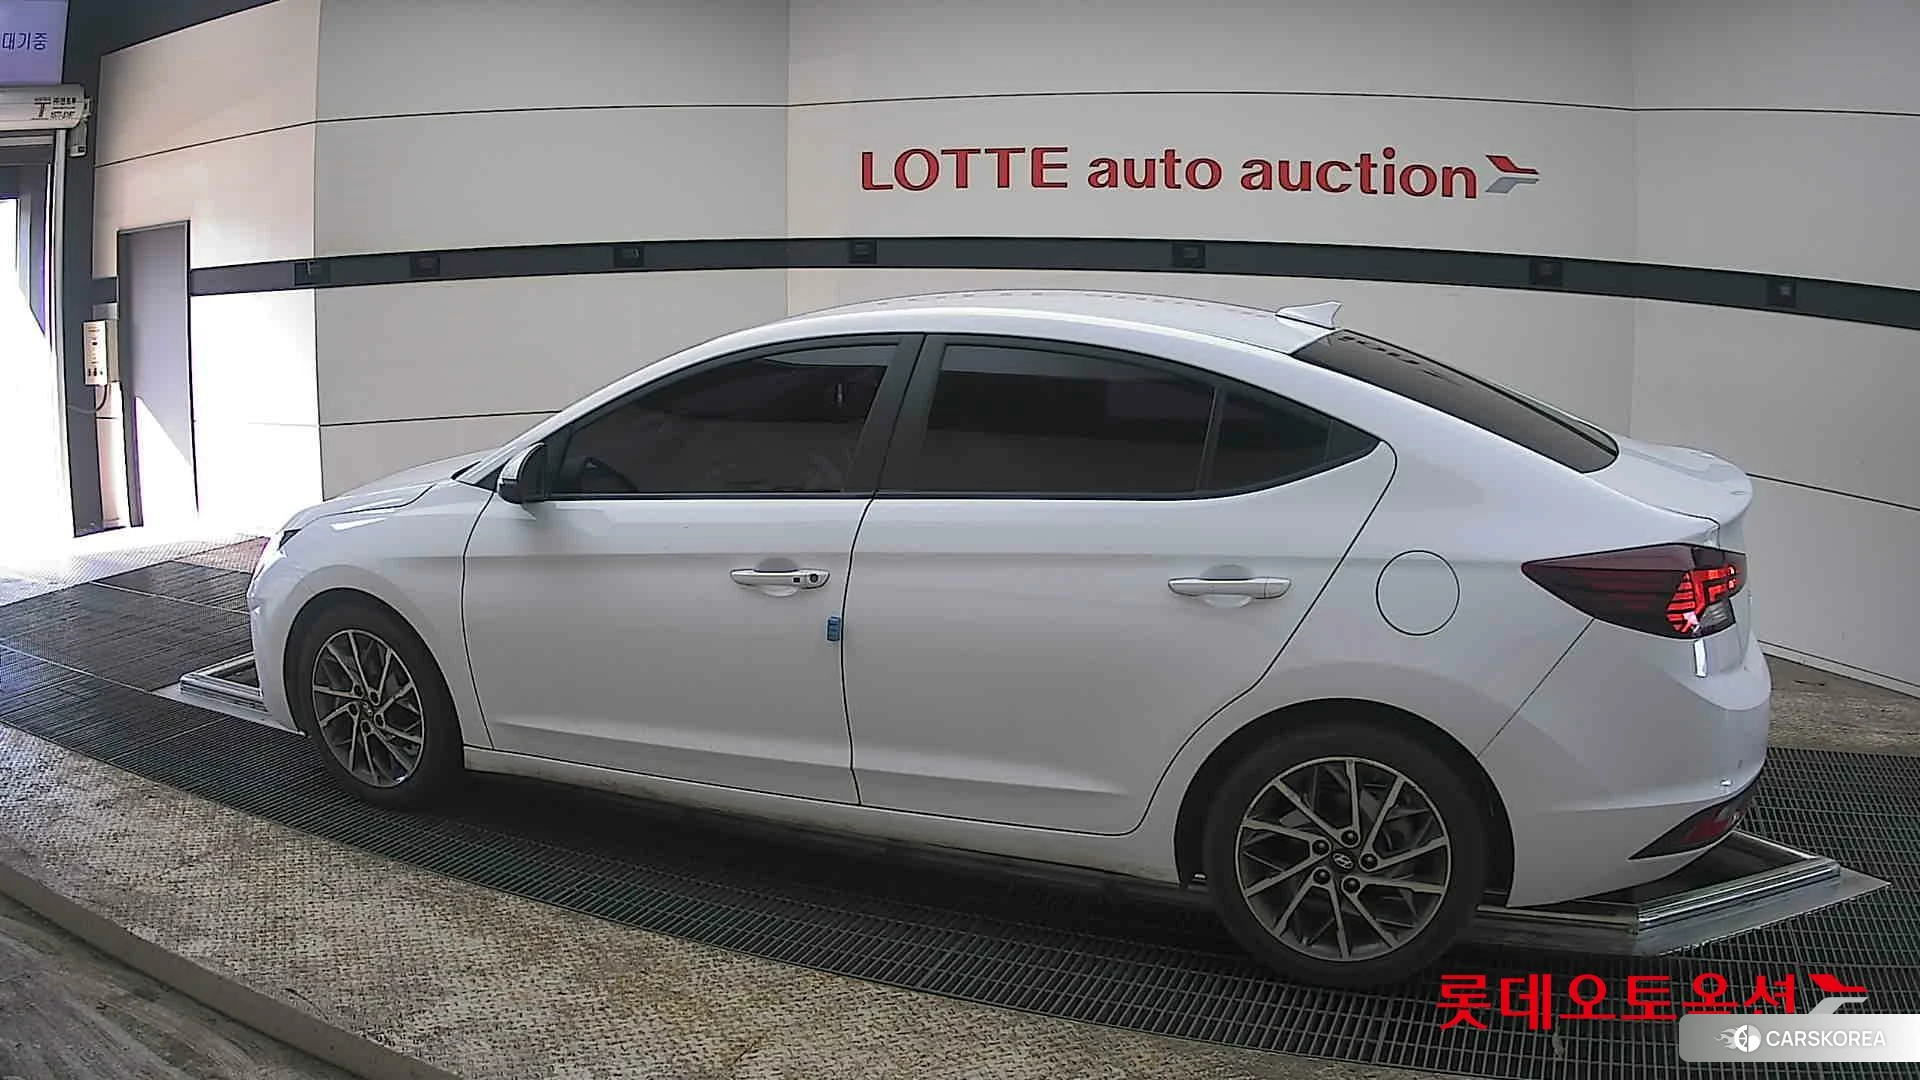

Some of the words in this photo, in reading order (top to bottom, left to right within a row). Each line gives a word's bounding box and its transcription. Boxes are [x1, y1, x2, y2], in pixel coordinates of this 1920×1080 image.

[861, 146, 1068, 191] LOTTE
[1087, 148, 1223, 190] auto
[1240, 147, 1478, 199] auction
